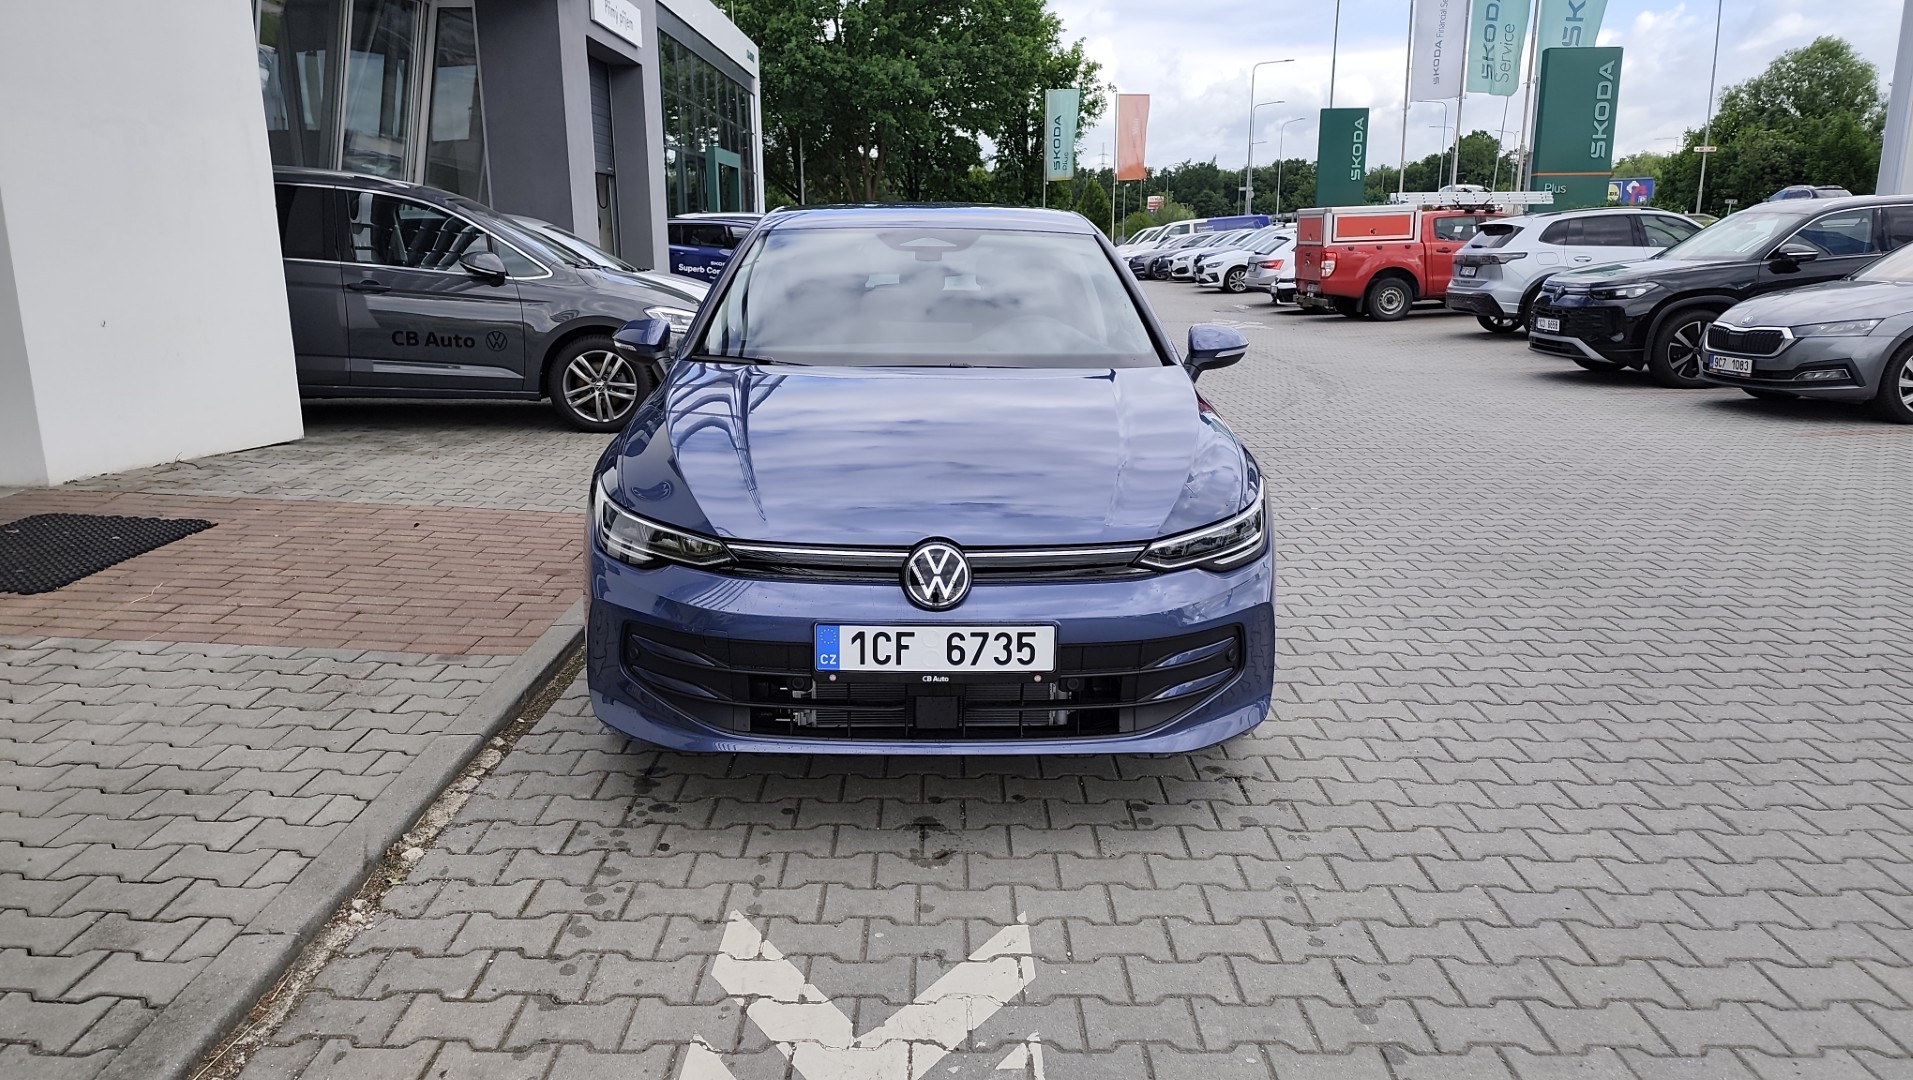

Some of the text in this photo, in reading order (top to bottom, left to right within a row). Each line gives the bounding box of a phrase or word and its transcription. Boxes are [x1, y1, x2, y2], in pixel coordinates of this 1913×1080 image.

[1436, 8, 1448, 38] Financial
[1495, 23, 1515, 83] Service
[1544, 183, 1567, 194] Plus
[678, 263, 705, 273] Superb
[391, 330, 476, 349] CB Auto
[1714, 356, 1727, 369] 9C7
[851, 631, 1036, 666] 1CF 6735
[820, 654, 837, 665] CZ
[933, 675, 949, 683] Auto
